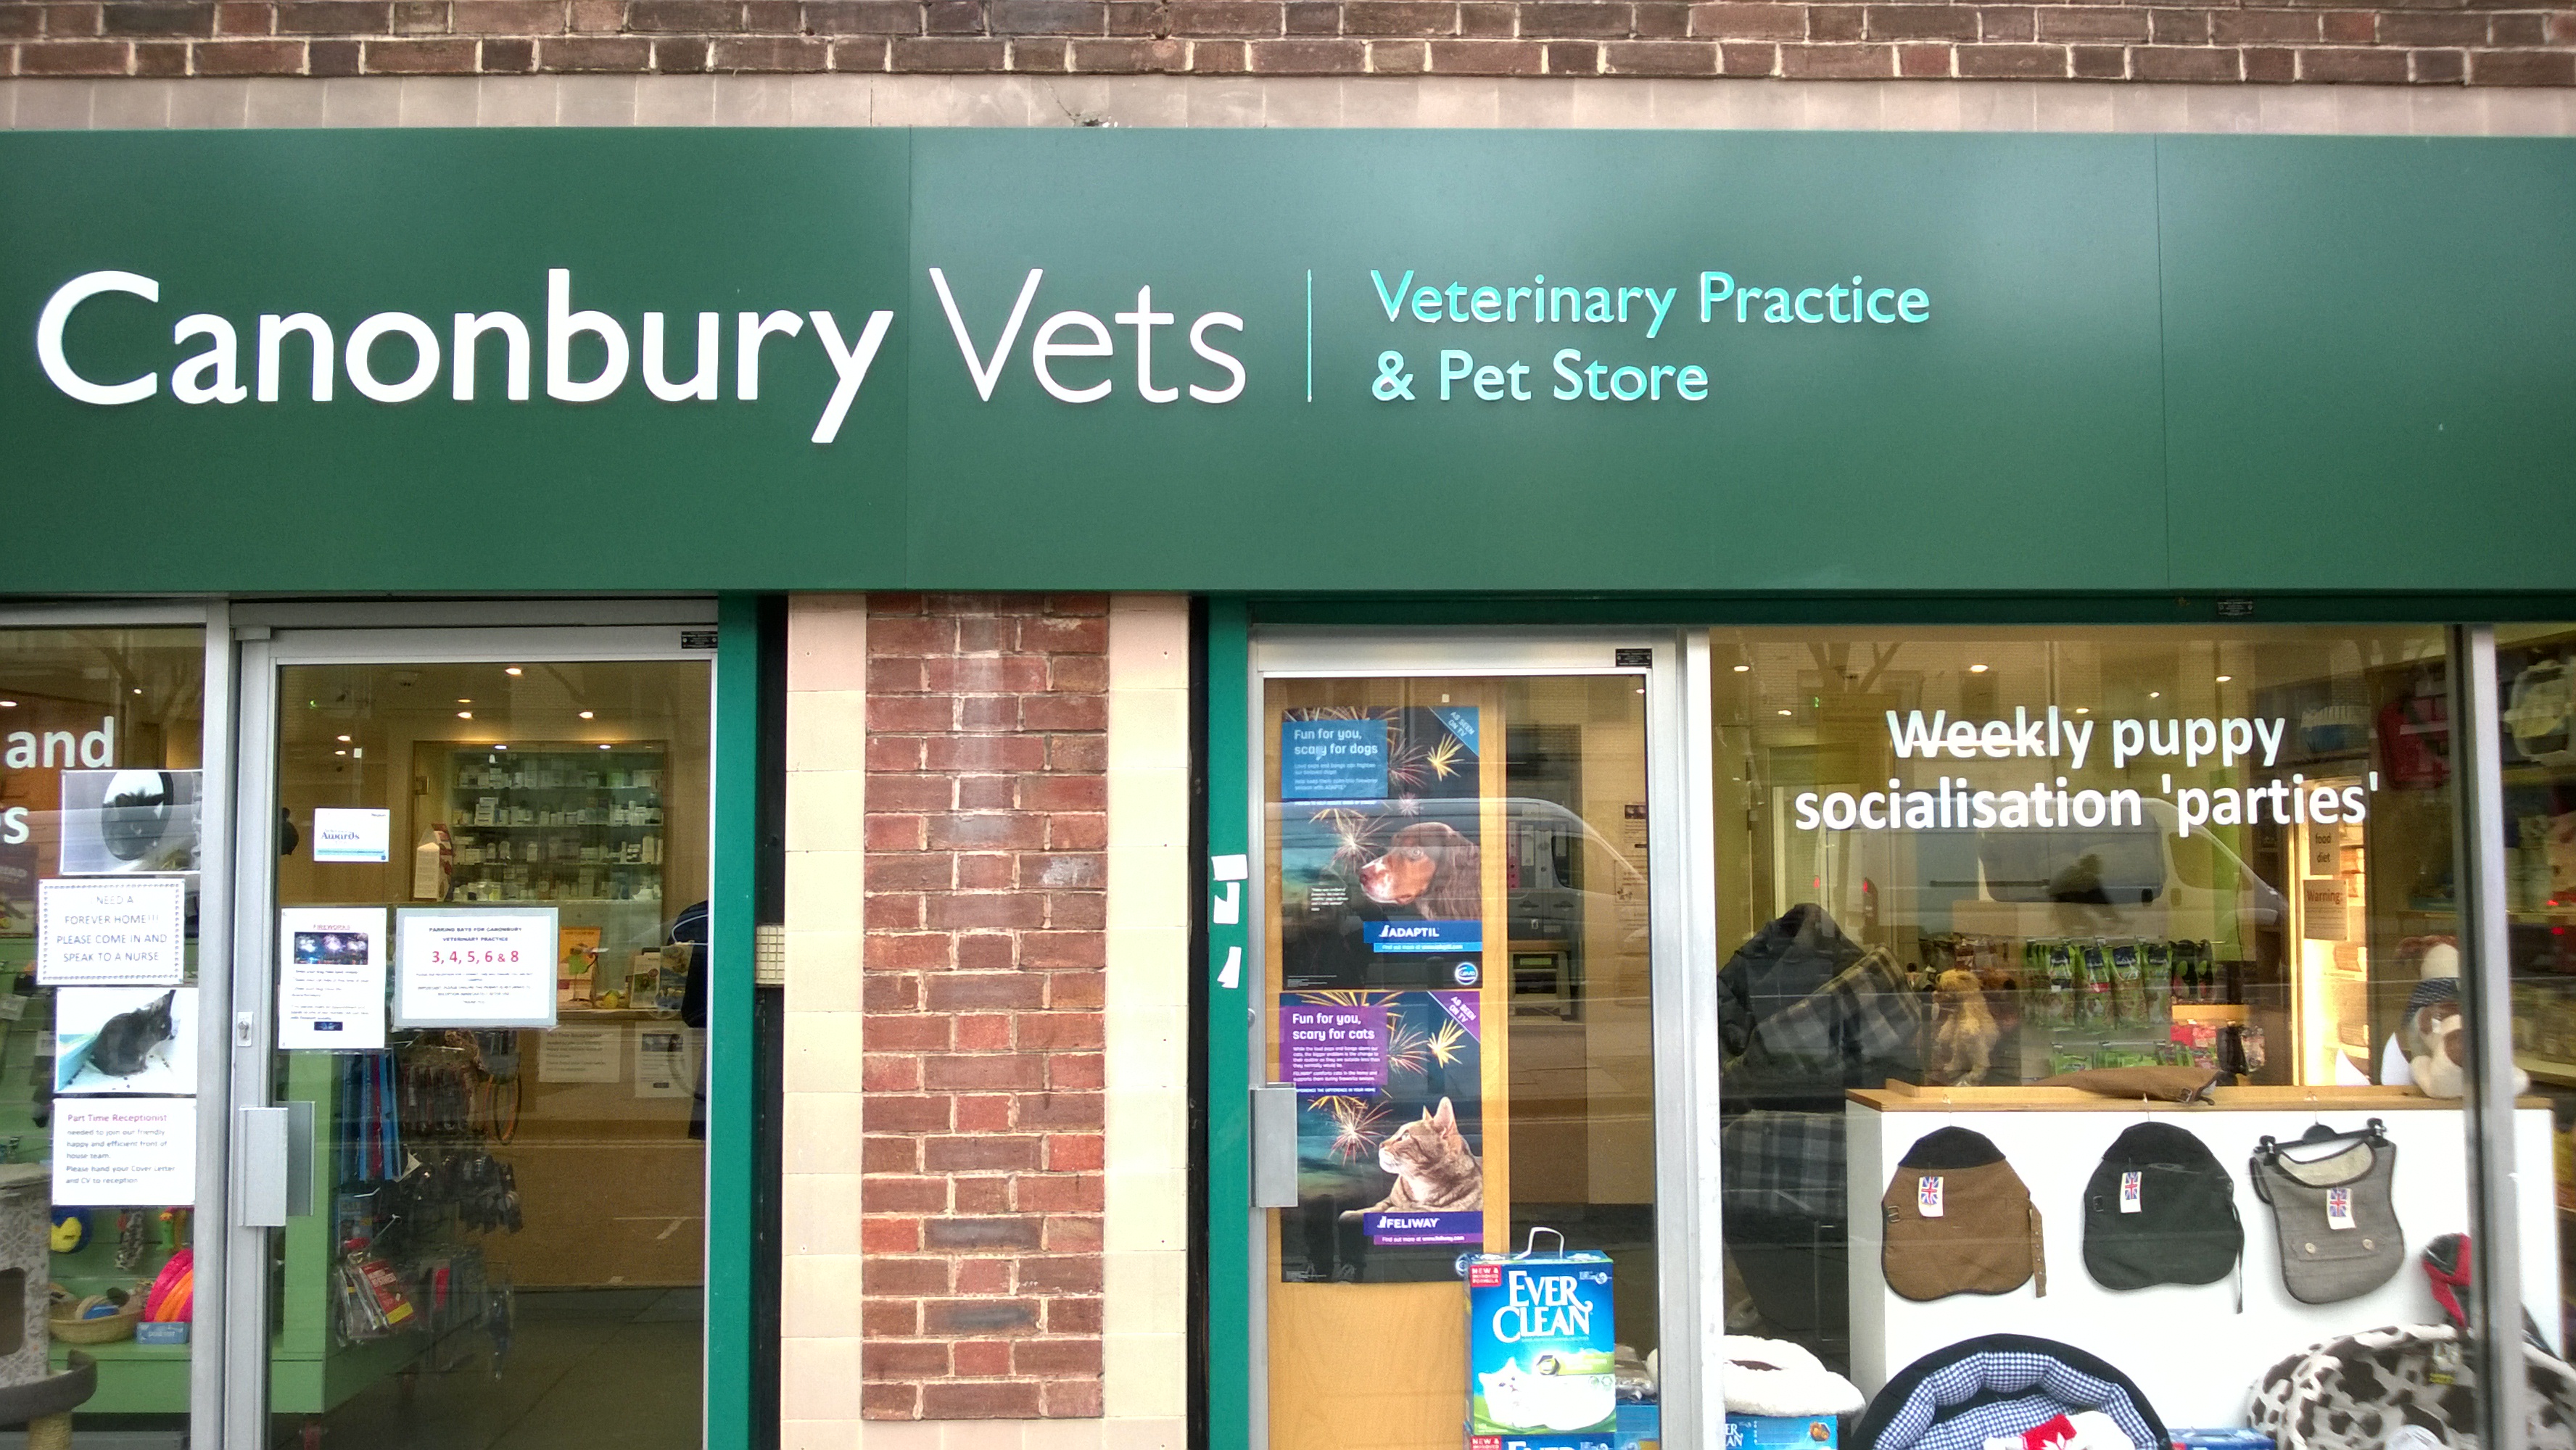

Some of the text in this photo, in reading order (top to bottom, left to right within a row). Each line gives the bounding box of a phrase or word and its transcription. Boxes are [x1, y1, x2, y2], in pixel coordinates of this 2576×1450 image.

[1369, 269, 1931, 339] Veterinary Practice
[37, 268, 1247, 444] Canonbury Vets
[1371, 348, 1709, 402] & Pet Store
[1448, 720, 1468, 737] ON TV
[1450, 711, 1475, 735] AS SEEN
[6, 716, 115, 768] and
[1294, 729, 1362, 741] Fun for you,
[1886, 705, 2287, 770] Weekly puppy
[1294, 743, 1378, 756] scary for dogs
[1794, 771, 2379, 838] socialisation 'parties'
[2315, 833, 2332, 844] food
[2317, 852, 2331, 863] diet
[96, 895, 123, 905] NEED
[127, 895, 133, 904] A
[65, 914, 159, 924] FOREVER HOME!!!
[1389, 927, 1440, 937] ADAPTIL
[57, 934, 168, 945] PLEASE COME IN AND
[63, 952, 159, 962] SPEAK TO A NURSE
[432, 950, 519, 965] 3, 4, 5, 6 & 8
[1449, 1005, 1469, 1022] ON TV
[1450, 996, 1477, 1021] AS SEEN
[1292, 1013, 1362, 1026] Fun for you,
[1292, 1028, 1375, 1041] scary for cats
[67, 1114, 168, 1123] Part Time Receptionist
[1387, 1218, 1440, 1228] FELIWAY
[1508, 1270, 1594, 1313] EVER
[1492, 1304, 1590, 1343] CLEAN
